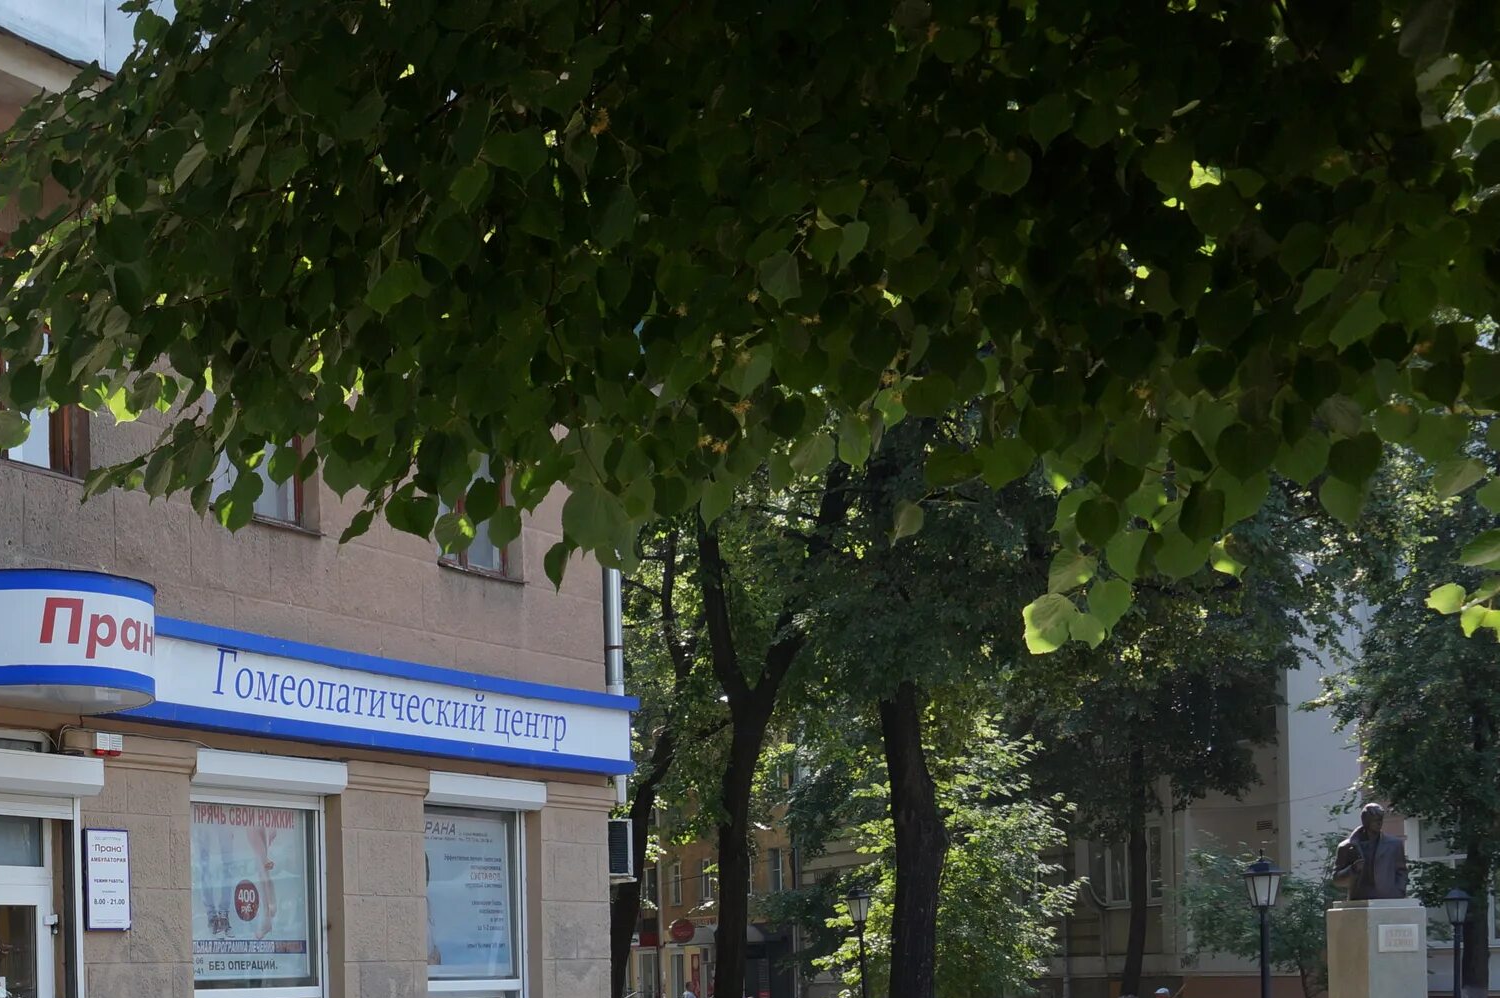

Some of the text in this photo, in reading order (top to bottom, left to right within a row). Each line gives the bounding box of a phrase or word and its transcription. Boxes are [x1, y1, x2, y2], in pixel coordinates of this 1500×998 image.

[212, 647, 568, 752] Гомеопатический центр
[193, 803, 295, 829] ПРЯЧЬ СВОИ НОЖКИ!
[424, 820, 456, 836] РАНА
[238, 889, 256, 903] 400
[213, 940, 248, 953] ПРОГРАММА
[208, 960, 226, 971] БЕЗ
